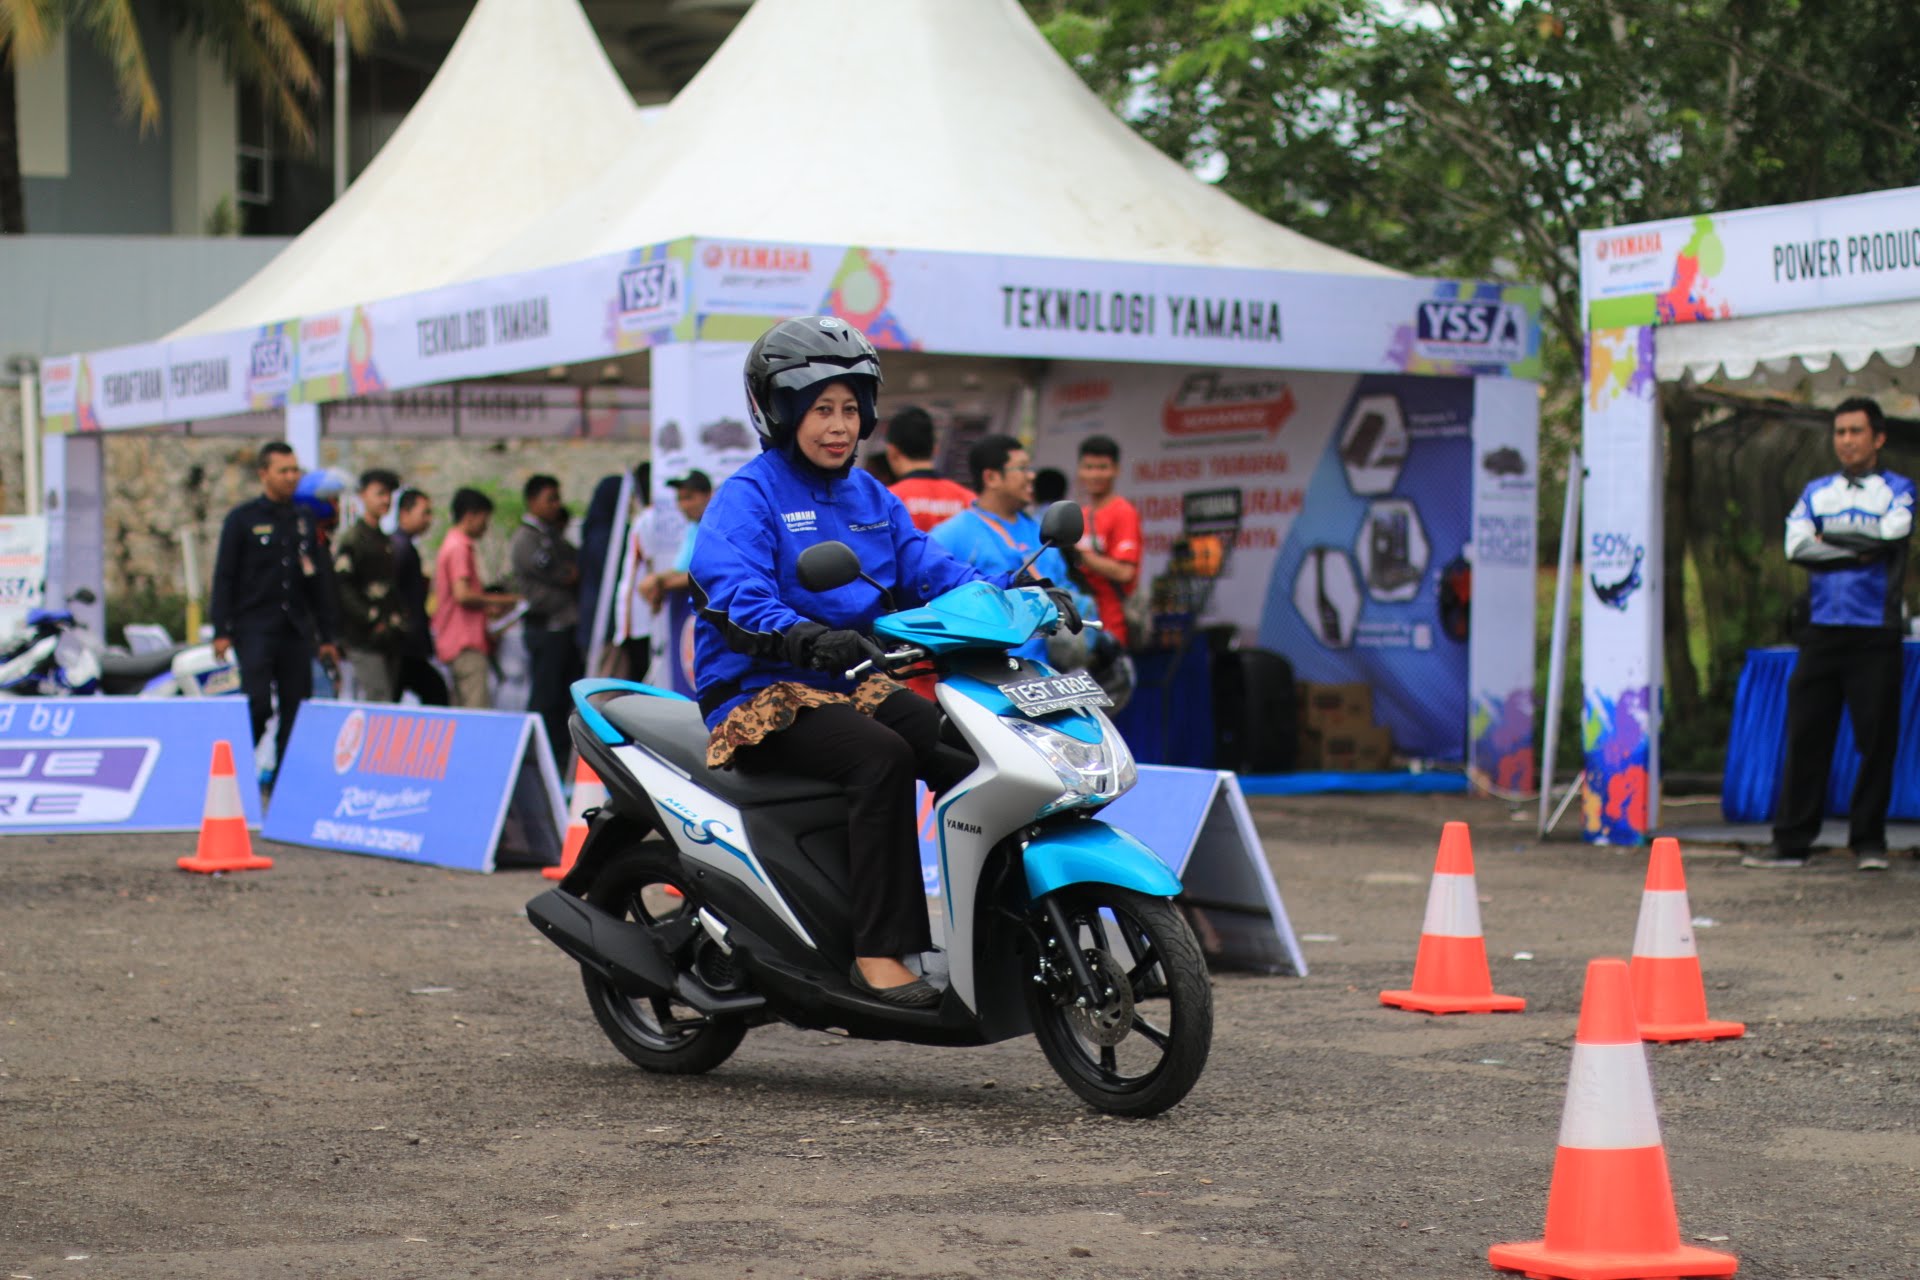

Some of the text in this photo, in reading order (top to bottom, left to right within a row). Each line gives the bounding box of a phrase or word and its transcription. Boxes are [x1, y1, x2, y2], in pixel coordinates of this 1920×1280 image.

[727, 247, 811, 272] YAMAHA
[1774, 238, 1841, 282] POWER
[416, 297, 551, 358] TEKNOLOGI YAMAHA
[1001, 286, 1283, 342] TEKNOLOGI YAMAHA
[785, 510, 817, 523] YAMAHA
[1592, 532, 1631, 557] 50%
[1003, 675, 1098, 703] TEST RIDE
[29, 703, 76, 737] by
[359, 714, 457, 780] YAMAHA
[946, 818, 982, 835] YAMAHA
